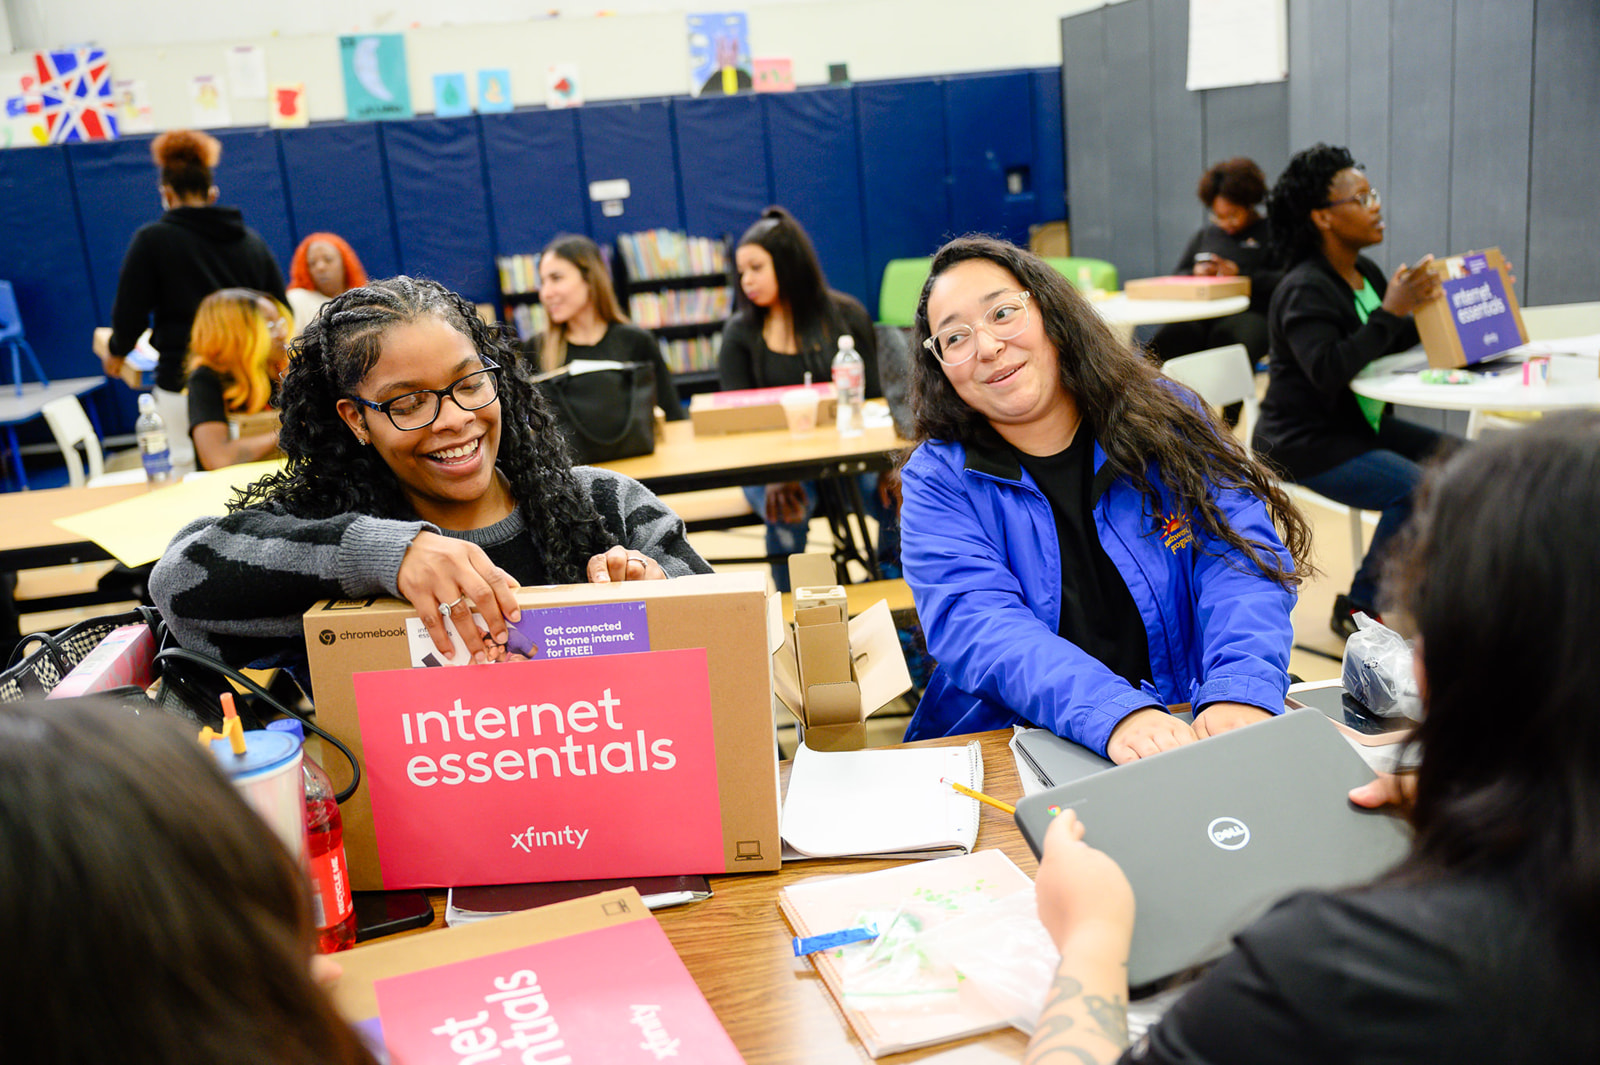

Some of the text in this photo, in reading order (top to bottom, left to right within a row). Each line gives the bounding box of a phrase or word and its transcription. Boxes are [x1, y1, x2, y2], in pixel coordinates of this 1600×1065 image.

[340, 626, 406, 641] chromebook
[544, 620, 622, 636] Get connected
[545, 631, 635, 647] to home internet
[546, 645, 594, 658] for FREE!
[402, 688, 623, 745] internet
[407, 729, 677, 787] essentials
[510, 825, 589, 853] xfinity
[1213, 825, 1246, 842] DELL
[331, 856, 340, 874] ME
[333, 872, 345, 916] RECYCLE
